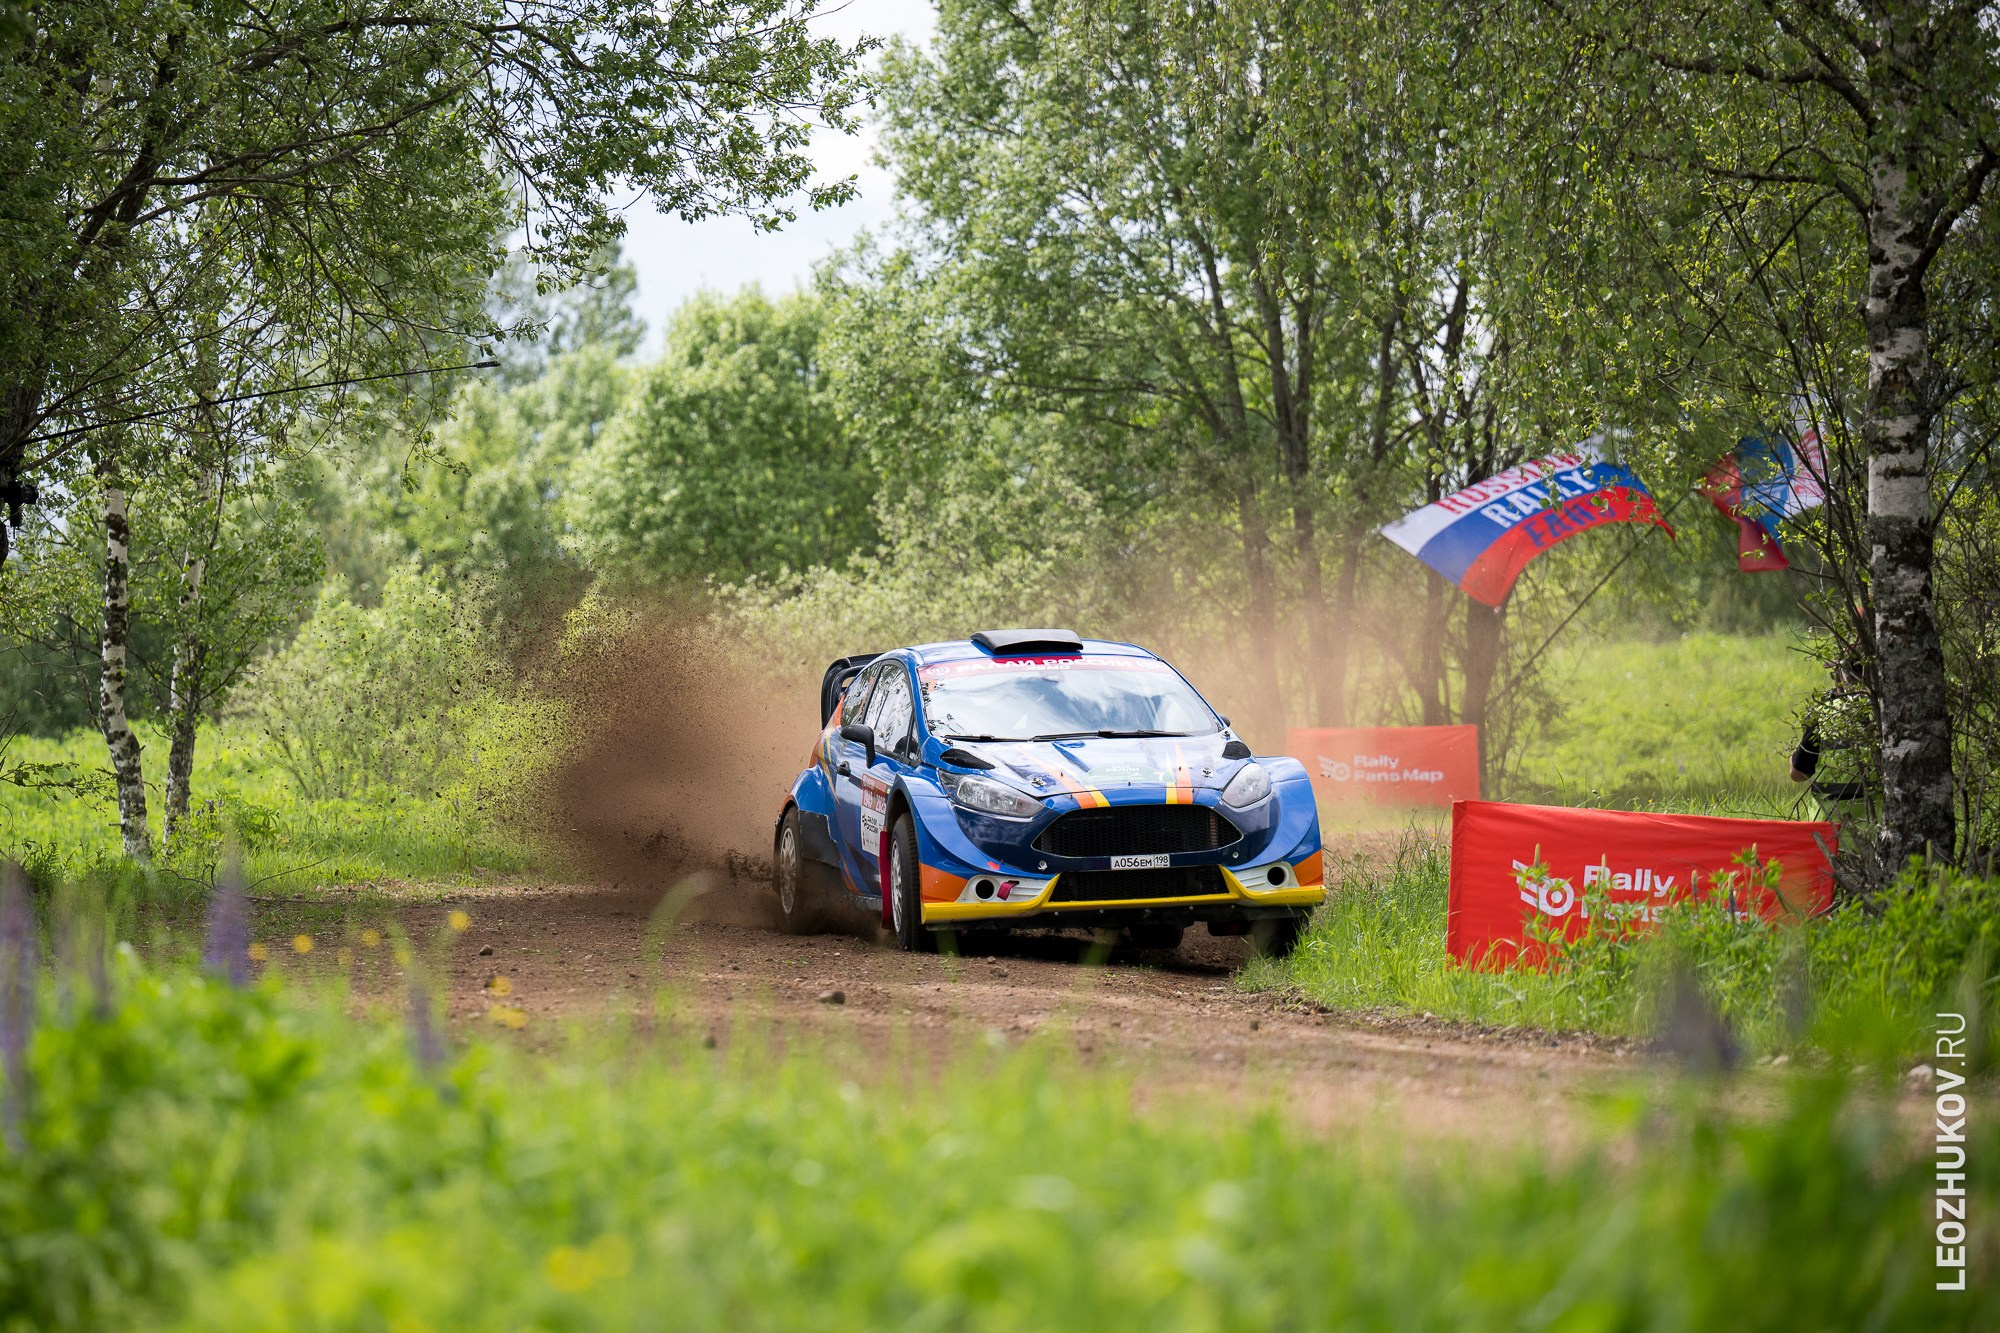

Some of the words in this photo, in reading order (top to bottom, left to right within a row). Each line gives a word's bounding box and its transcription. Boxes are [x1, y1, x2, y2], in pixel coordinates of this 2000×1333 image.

[1480, 470, 1597, 529] RALLY
[1353, 754, 1400, 769] Rally
[1353, 770, 1400, 782] Fans
[1402, 769, 1444, 783] Map
[1155, 855, 1169, 864] 198
[1583, 865, 1675, 898] Rally
